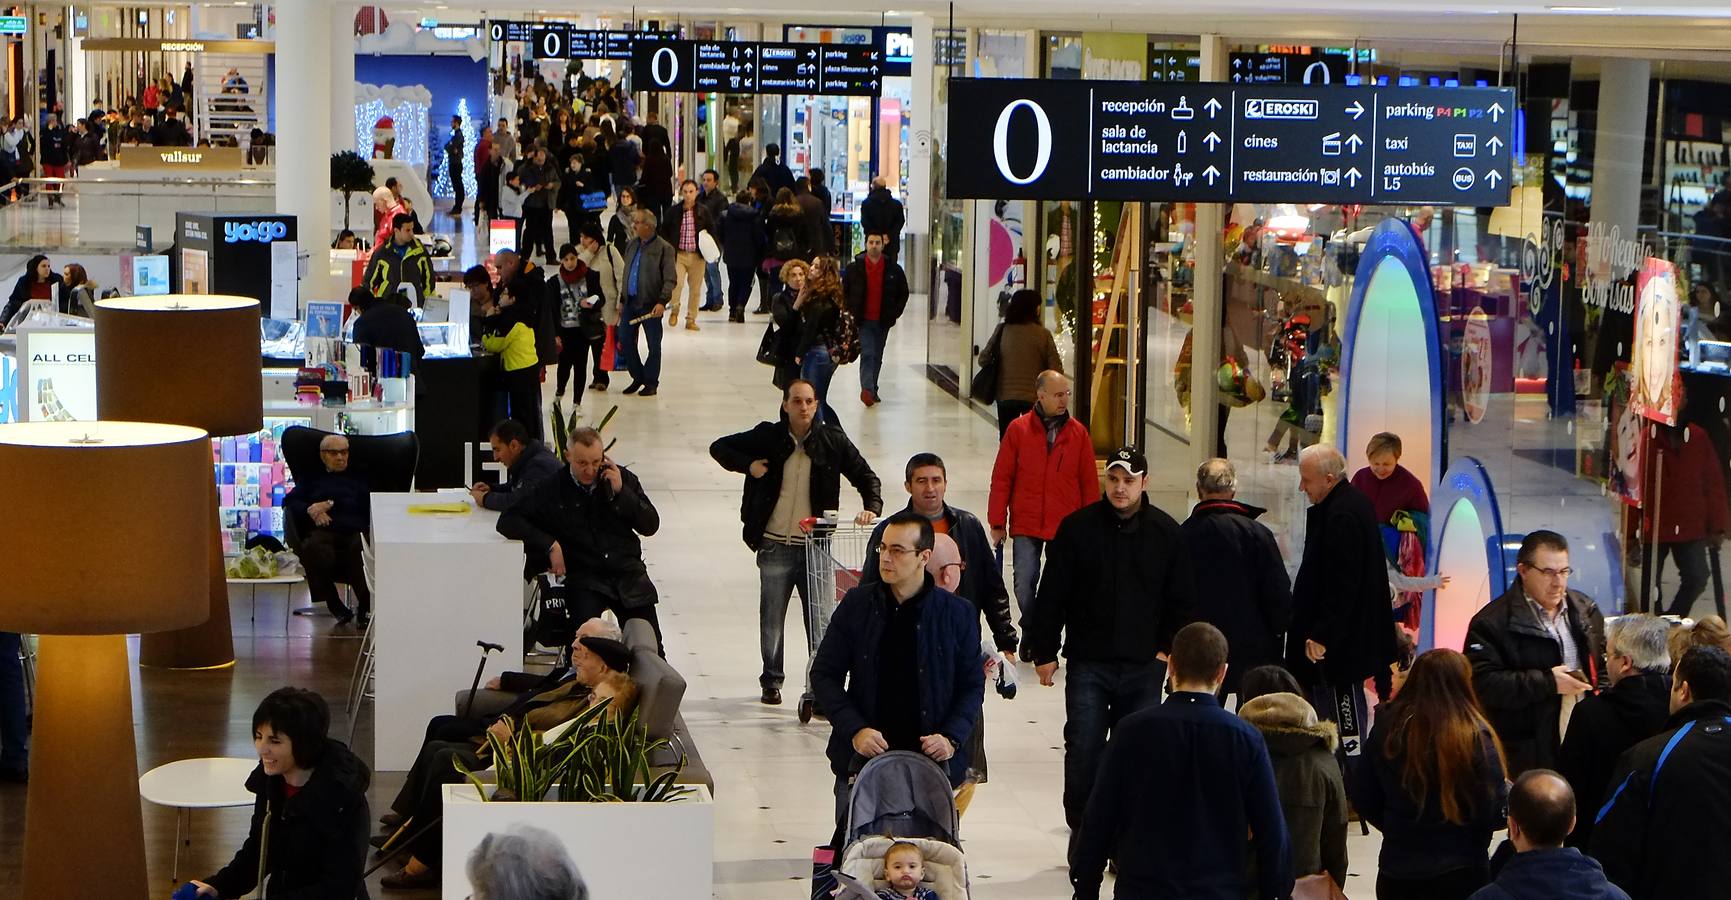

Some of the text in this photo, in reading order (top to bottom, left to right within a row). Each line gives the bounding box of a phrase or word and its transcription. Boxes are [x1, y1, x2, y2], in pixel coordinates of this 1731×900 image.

[491, 24, 503, 40] 0
[160, 42, 205, 52] RECEPCIÓN
[543, 32, 561, 57] 0
[825, 51, 848, 59] parking
[651, 47, 679, 87] 0
[698, 77, 718, 86] cajero
[825, 80, 848, 88] parking
[1101, 98, 1166, 115] recepción
[1265, 103, 1315, 115] EROSKI
[1385, 103, 1484, 120] parking P4 P1 P2
[1101, 125, 1147, 138] sala de
[993, 99, 1052, 185] 0
[1101, 140, 1158, 154] lactancia
[1243, 134, 1278, 148] cines
[1385, 137, 1409, 150] taxi
[1456, 140, 1474, 150] TAXI
[160, 151, 202, 163] vallsur
[1100, 166, 1169, 180] cambiador
[1383, 162, 1435, 175] autobús
[1243, 168, 1318, 183] restauración
[1455, 174, 1472, 183] BUS
[1383, 177, 1401, 190] L5
[224, 220, 287, 244] yoigo
[32, 353, 62, 362] ALL
